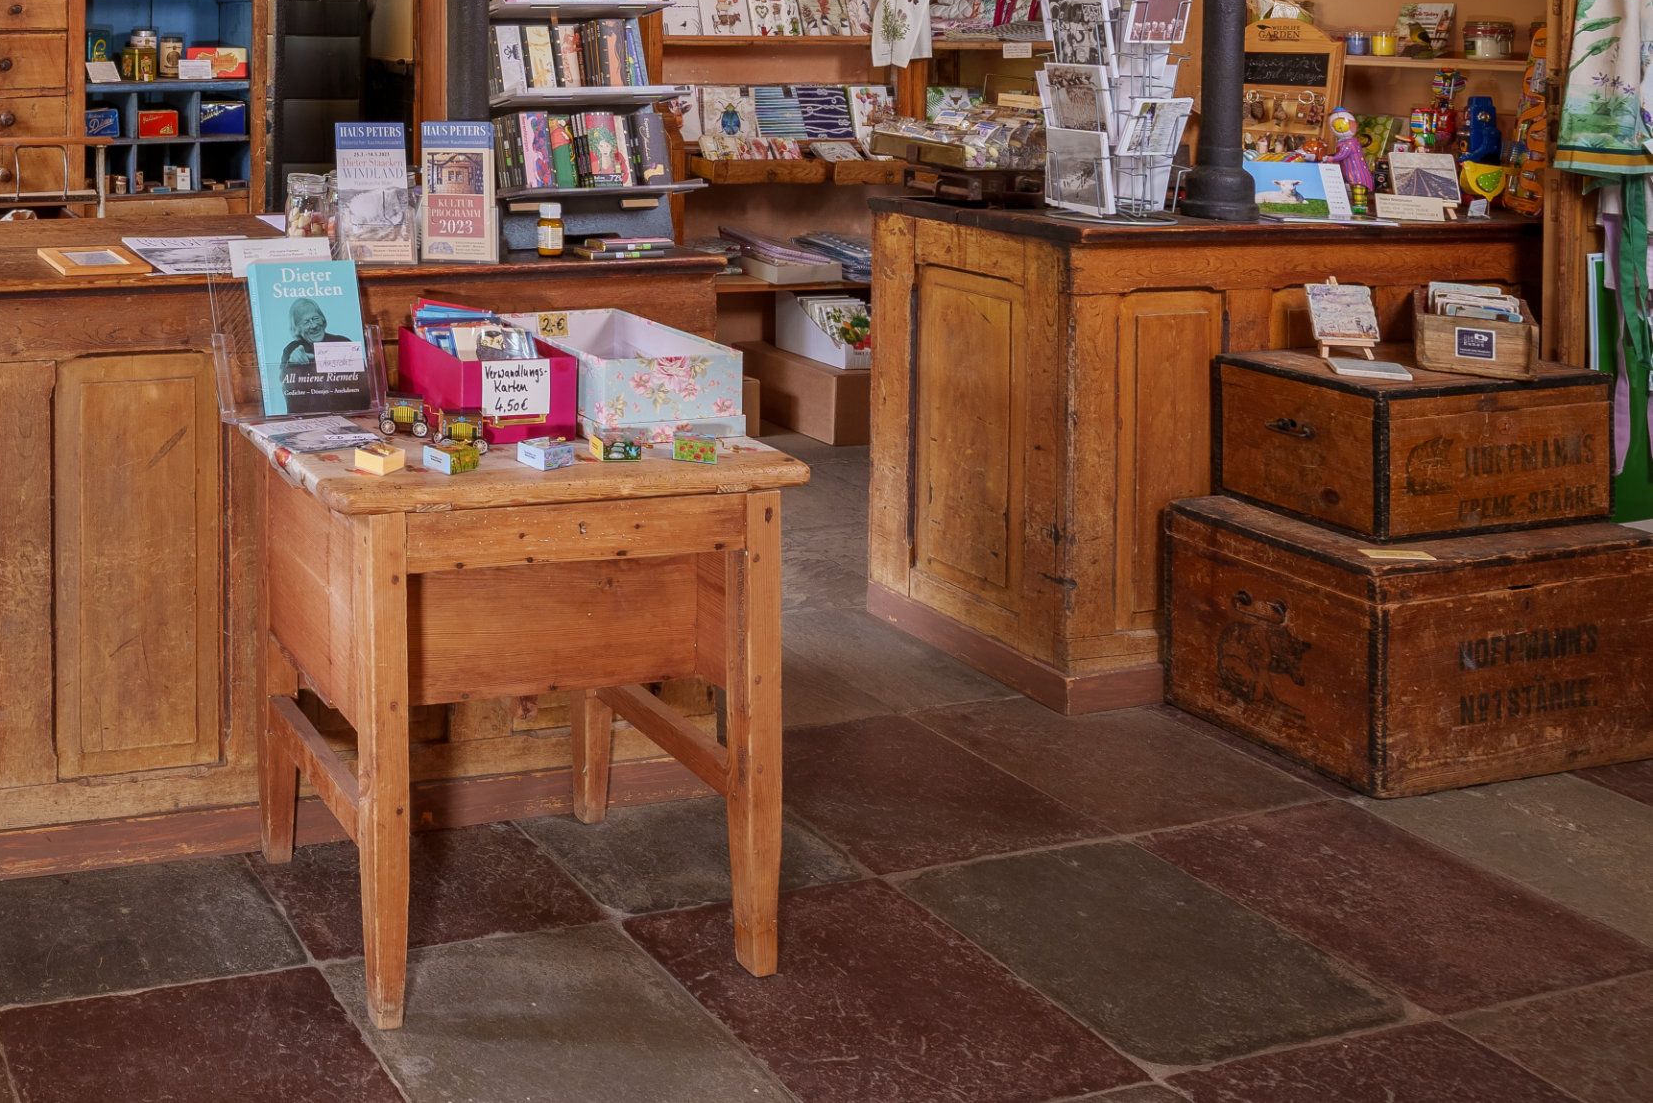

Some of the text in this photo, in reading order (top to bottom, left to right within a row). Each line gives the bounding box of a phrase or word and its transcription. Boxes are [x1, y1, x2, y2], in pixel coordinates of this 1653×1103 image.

[1257, 30, 1301, 40] GARDEN
[340, 126, 402, 138] HAUS PETERS
[423, 124, 487, 136] HAUS PETERS
[342, 157, 403, 168] Dieter Staacken
[341, 168, 404, 179] WINDLAND
[437, 198, 475, 208] KULTUR
[431, 208, 482, 218] PROGRAMM
[438, 219, 474, 235] 2023
[281, 268, 332, 283] Dieter
[272, 281, 344, 298] Staacken
[282, 371, 359, 384] All miene Riemels
[484, 364, 548, 383] Verwandlungs-
[494, 380, 528, 393] Karten
[494, 397, 529, 413] 4,50€
